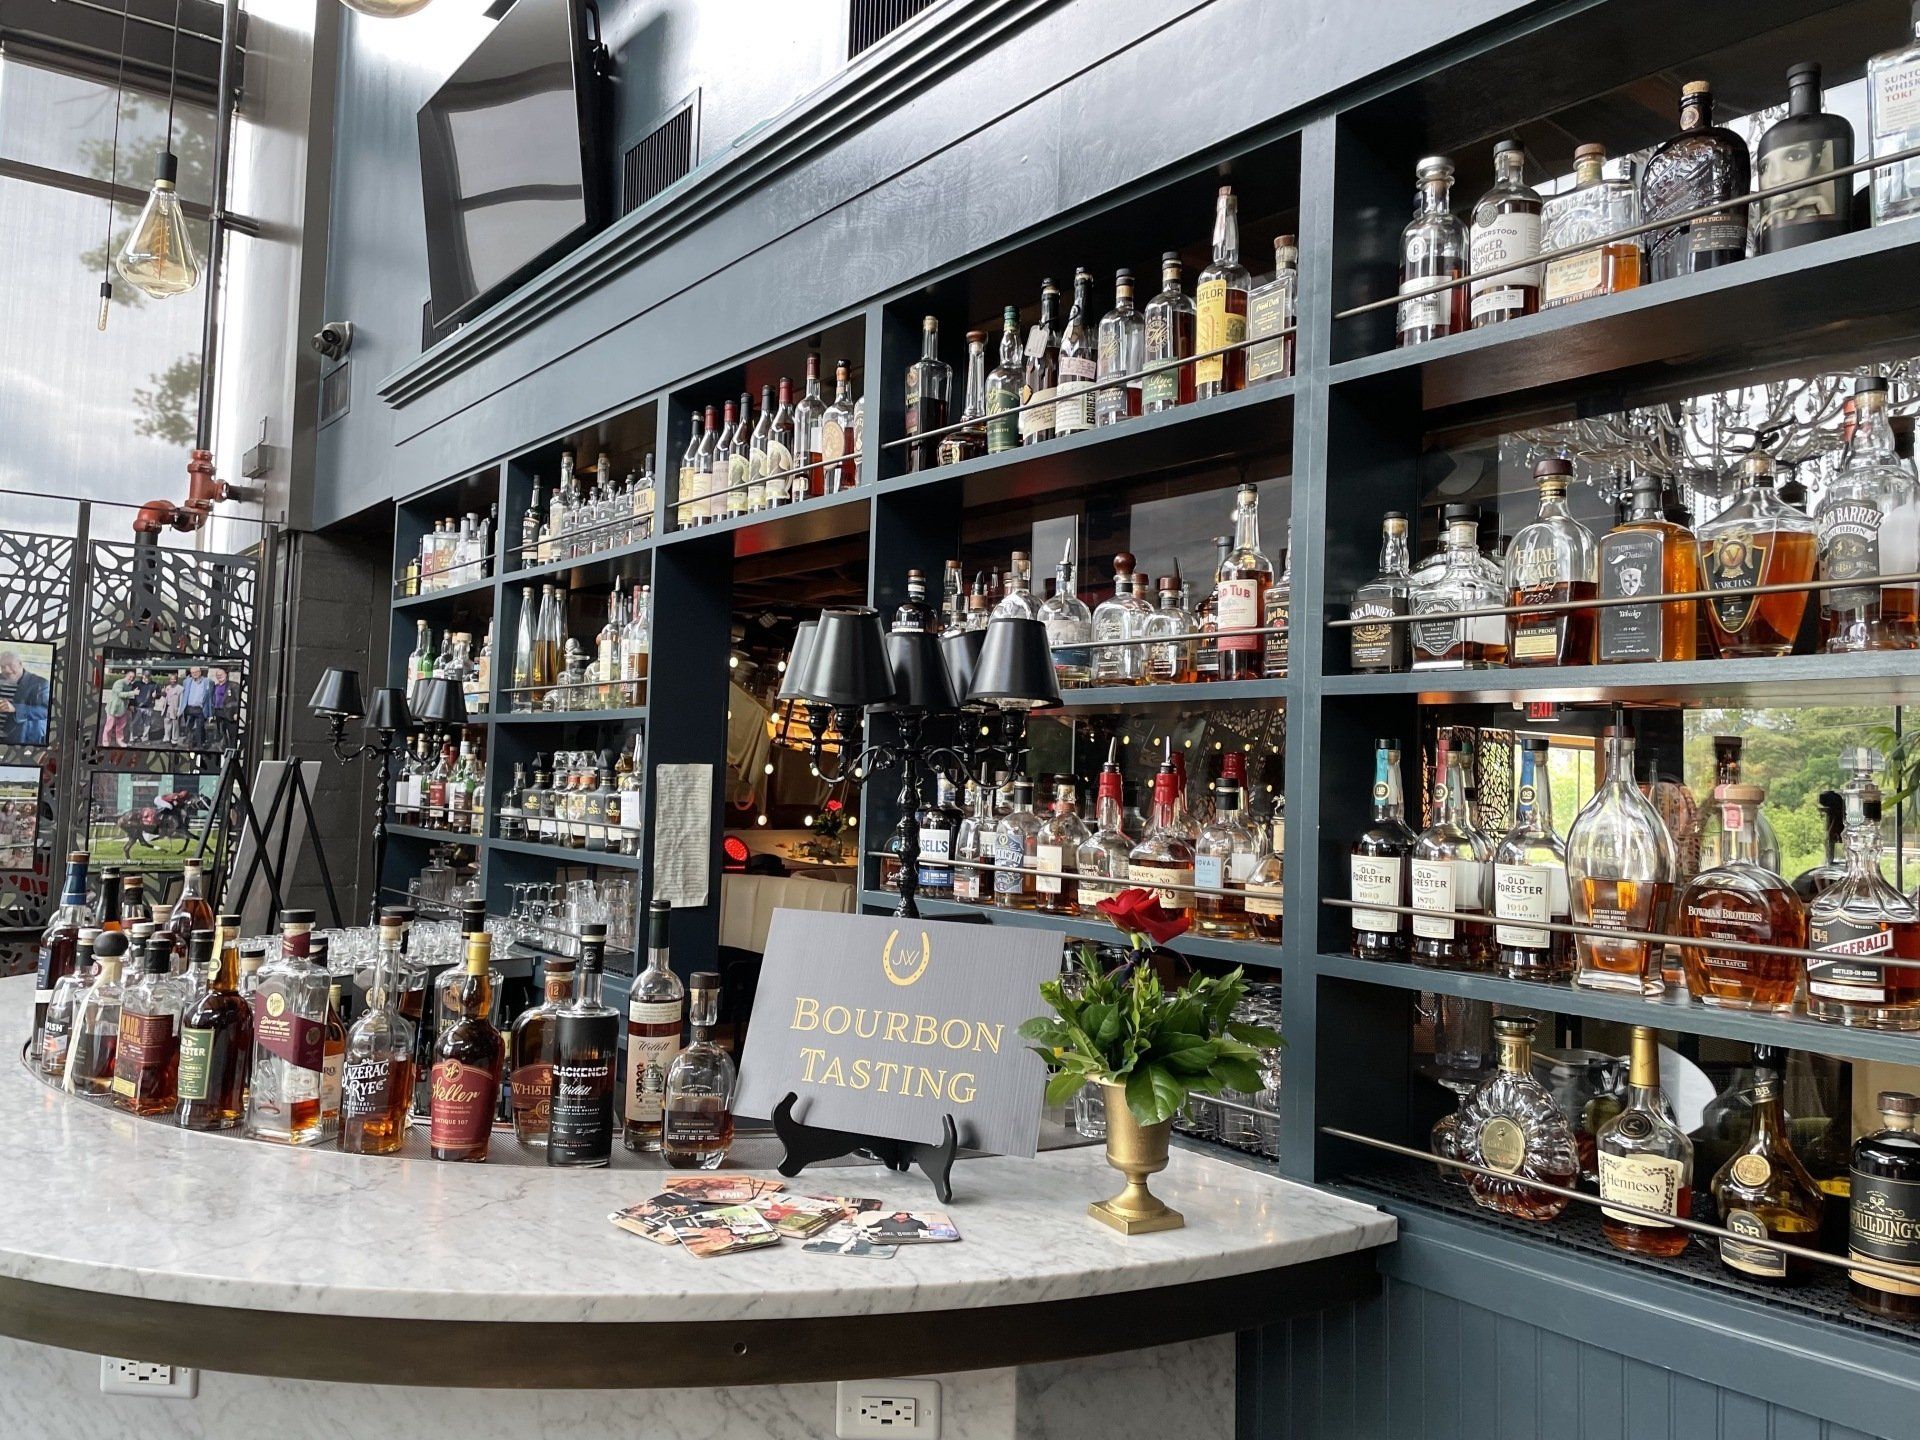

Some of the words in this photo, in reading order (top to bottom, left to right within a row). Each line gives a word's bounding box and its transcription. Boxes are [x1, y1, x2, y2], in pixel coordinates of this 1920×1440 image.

[1885, 91, 1912, 103] TOKI
[1413, 243, 1421, 256] B
[1198, 288, 1224, 301] AYLOR
[1836, 505, 1882, 528] BARREL
[1229, 584, 1251, 599] TUB
[1538, 627, 1557, 635] PROOF
[1361, 866, 1376, 875] OLD
[1418, 870, 1431, 878] OLD
[1353, 872, 1391, 884] FORESTER
[1508, 876, 1525, 885] OLD
[1497, 882, 1543, 895] FORESTER
[1687, 905, 1722, 919] BOWMAN
[1722, 908, 1763, 922] BROTHERS
[1725, 960, 1747, 968] BATCH
[550, 985, 559, 996] 12
[121, 1014, 139, 1036] KNOB
[790, 997, 1005, 1054] BOURBON
[180, 1045, 206, 1057] ESTER
[637, 1040, 669, 1052] Willett
[342, 1061, 390, 1087] SAZERAC
[800, 1048, 977, 1104] TASTING
[431, 1076, 481, 1103] Weller
[1605, 1170, 1661, 1196] Hennessy
